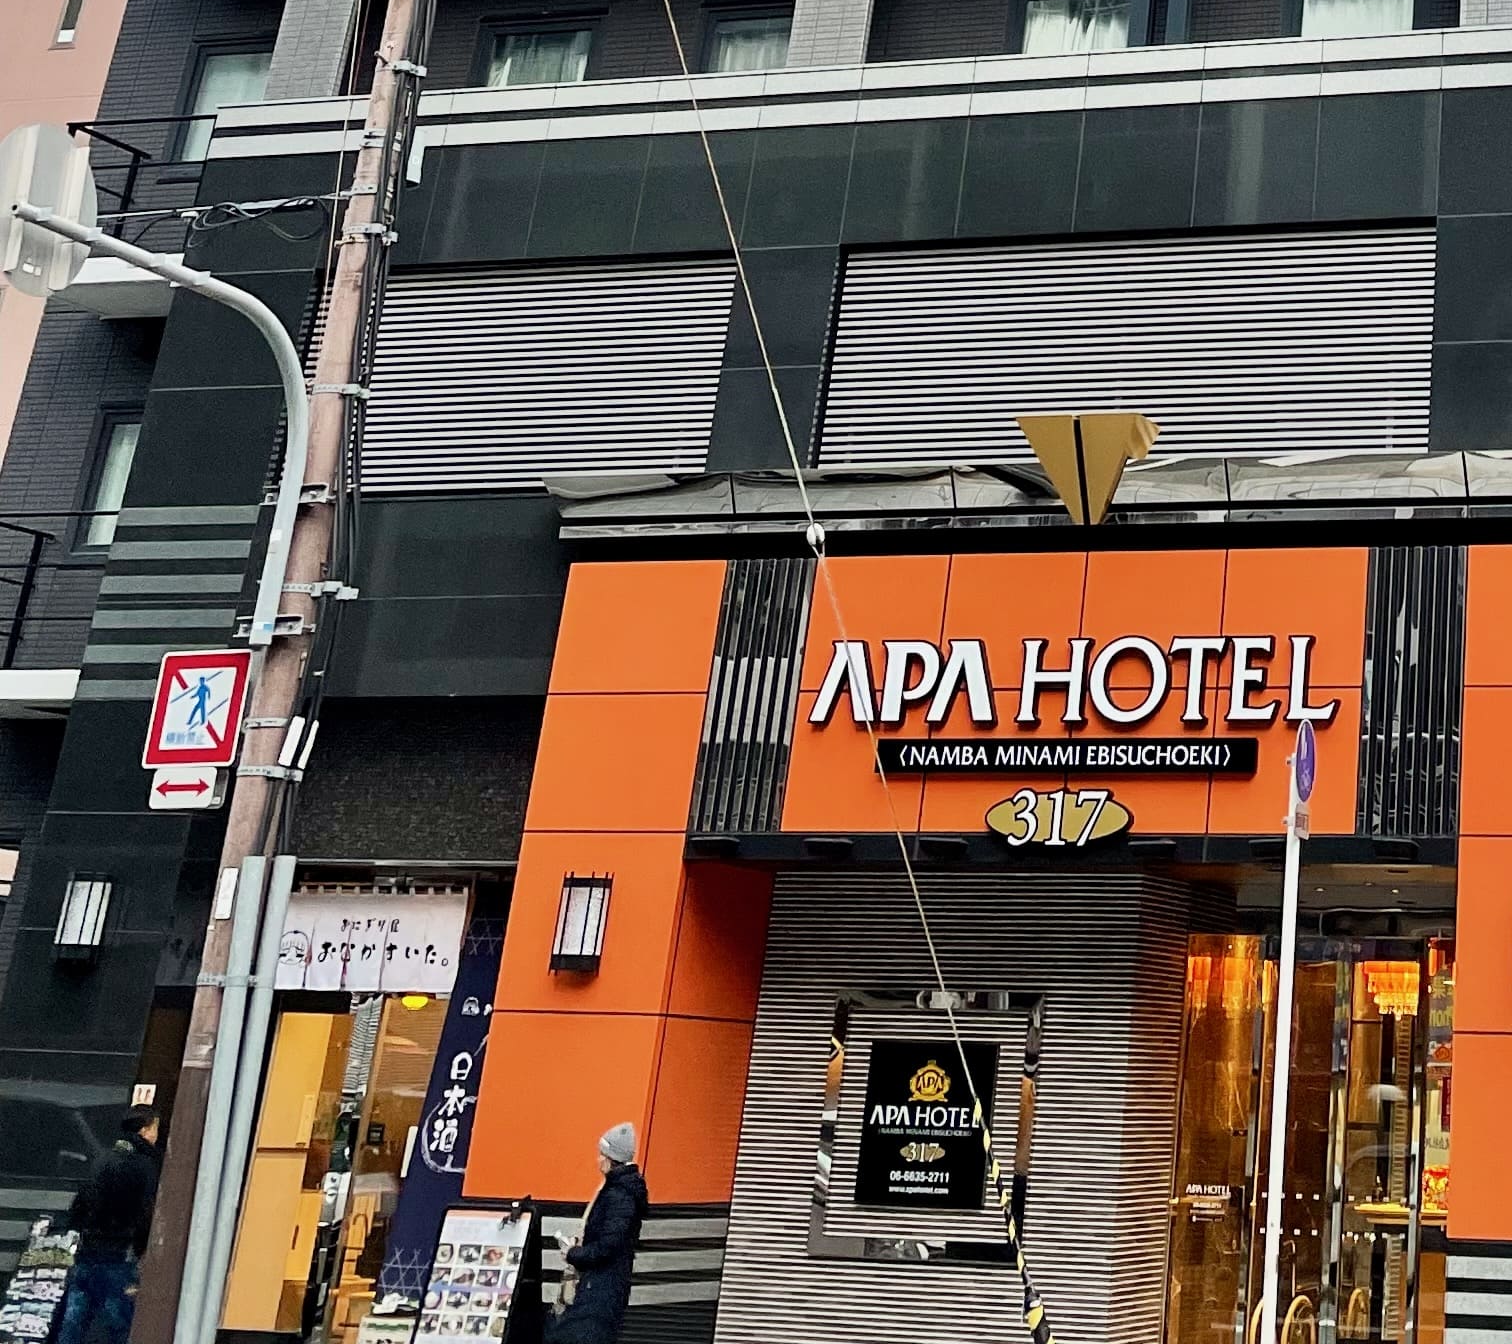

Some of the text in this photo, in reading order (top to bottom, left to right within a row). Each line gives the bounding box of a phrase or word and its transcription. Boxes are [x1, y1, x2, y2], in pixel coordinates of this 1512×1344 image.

[808, 635, 1341, 725] APA HOTEL
[995, 745, 1079, 767] MINAMI
[1006, 789, 1112, 848] 317
[869, 1105, 911, 1126] APA
[905, 1142, 940, 1162] 317
